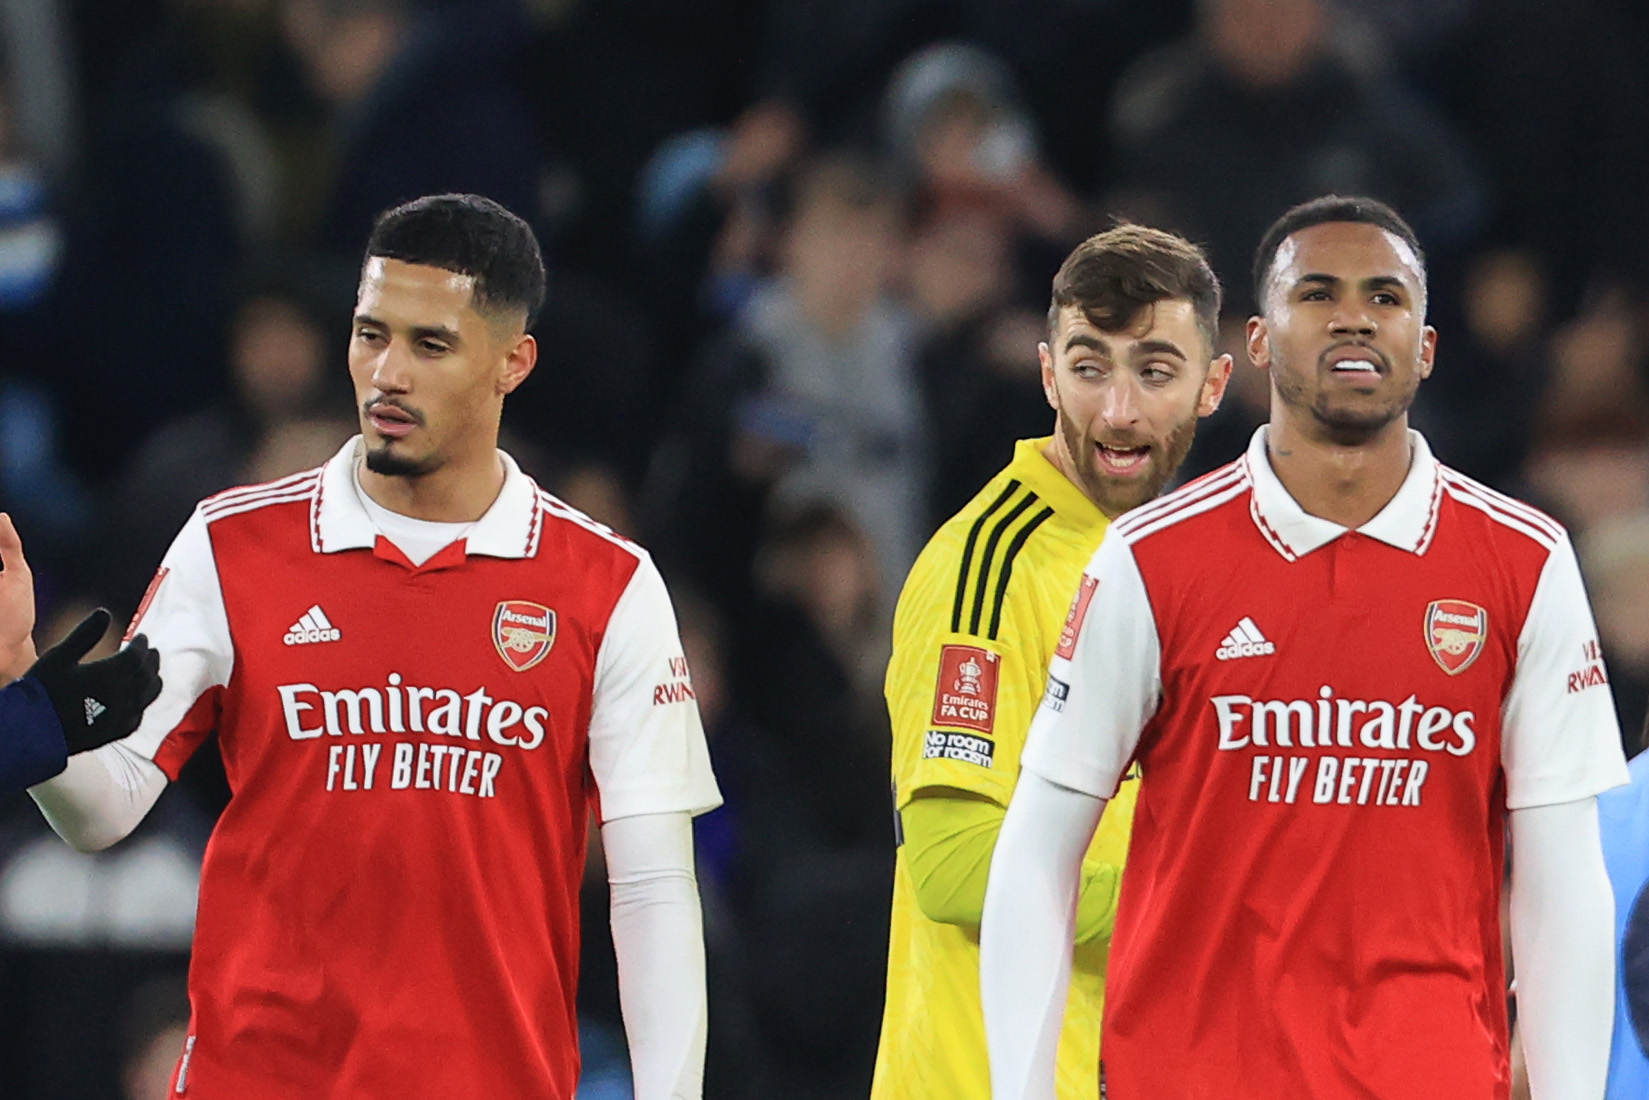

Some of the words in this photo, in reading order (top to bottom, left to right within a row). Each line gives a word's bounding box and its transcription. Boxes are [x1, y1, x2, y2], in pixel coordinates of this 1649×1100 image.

[502, 609, 547, 628] Arsenal
[1434, 609, 1479, 628] Arsenal
[283, 626, 342, 646] adidas
[1215, 640, 1276, 661] adidas
[276, 672, 550, 750] Emirates
[942, 694, 989, 710] Emirates
[941, 705, 958, 718] FA
[959, 707, 989, 721] CUP
[1209, 684, 1476, 757] Emirates
[925, 730, 947, 747] No
[947, 733, 990, 755] room
[945, 747, 992, 768] racism
[326, 742, 383, 792] FLY
[390, 742, 503, 798] BETTER
[1249, 755, 1308, 804] FLY
[1312, 755, 1429, 807] BETTER
